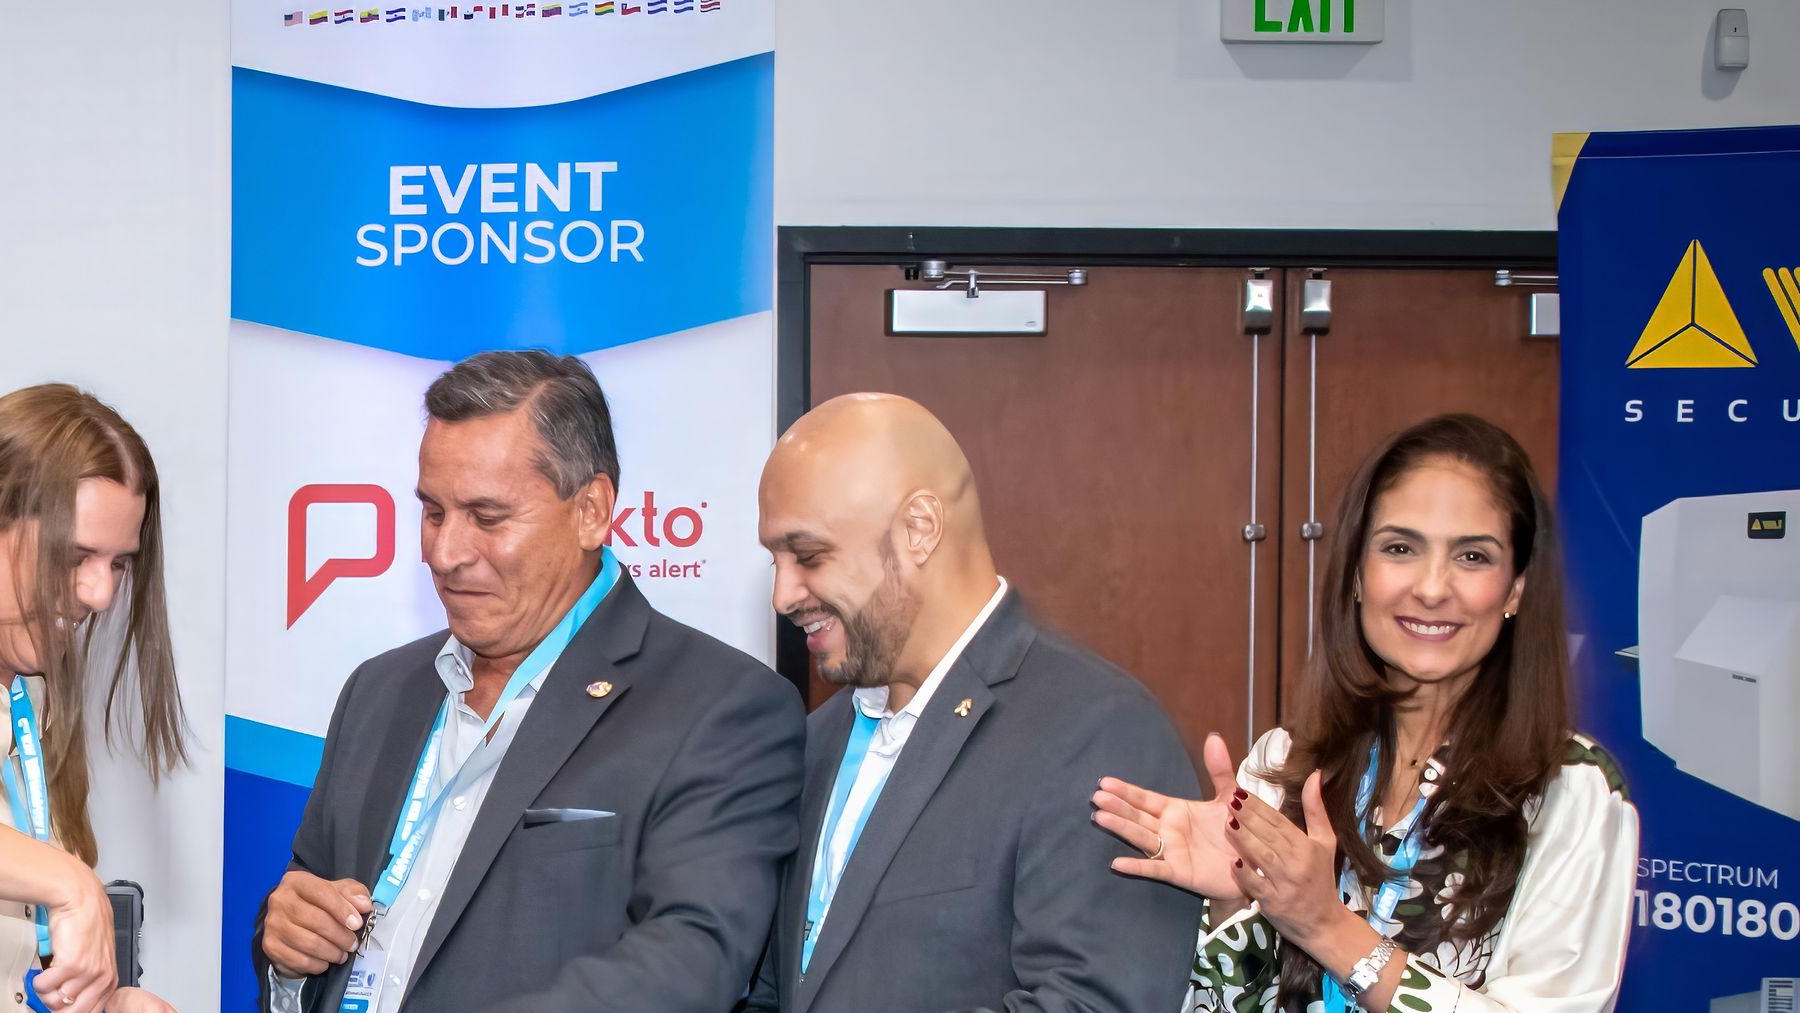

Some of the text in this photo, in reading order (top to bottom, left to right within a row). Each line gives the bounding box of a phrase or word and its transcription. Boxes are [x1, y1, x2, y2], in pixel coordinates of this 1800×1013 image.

[388, 161, 618, 216] EVENT
[355, 219, 645, 267] SPONSOR
[649, 559, 701, 578] alert
[1637, 858, 1778, 889] SPECTRUM
